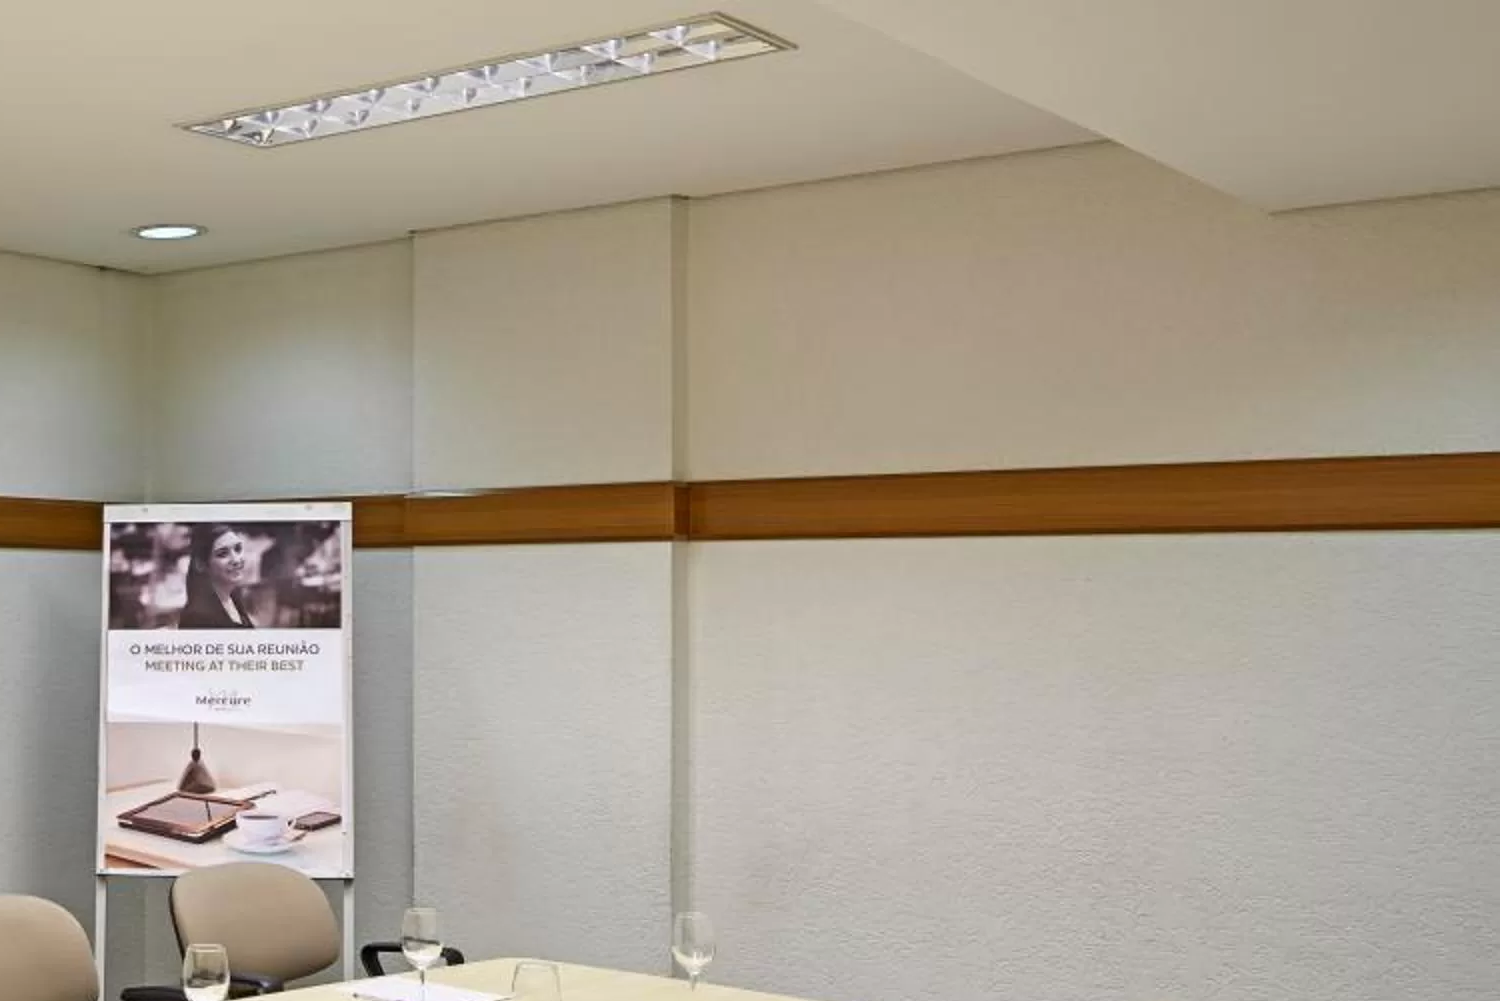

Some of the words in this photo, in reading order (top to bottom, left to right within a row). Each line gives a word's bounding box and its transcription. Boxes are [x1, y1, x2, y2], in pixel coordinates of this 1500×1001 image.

[129, 643, 141, 655] O
[143, 643, 203, 655] MELHOR
[205, 643, 225, 655] DE
[227, 643, 255, 655] SUA
[257, 639, 321, 655] REUNIÃO
[144, 659, 205, 672] MEETING
[208, 659, 224, 672] AT
[228, 659, 267, 671] THEIR
[271, 659, 304, 671] BEST
